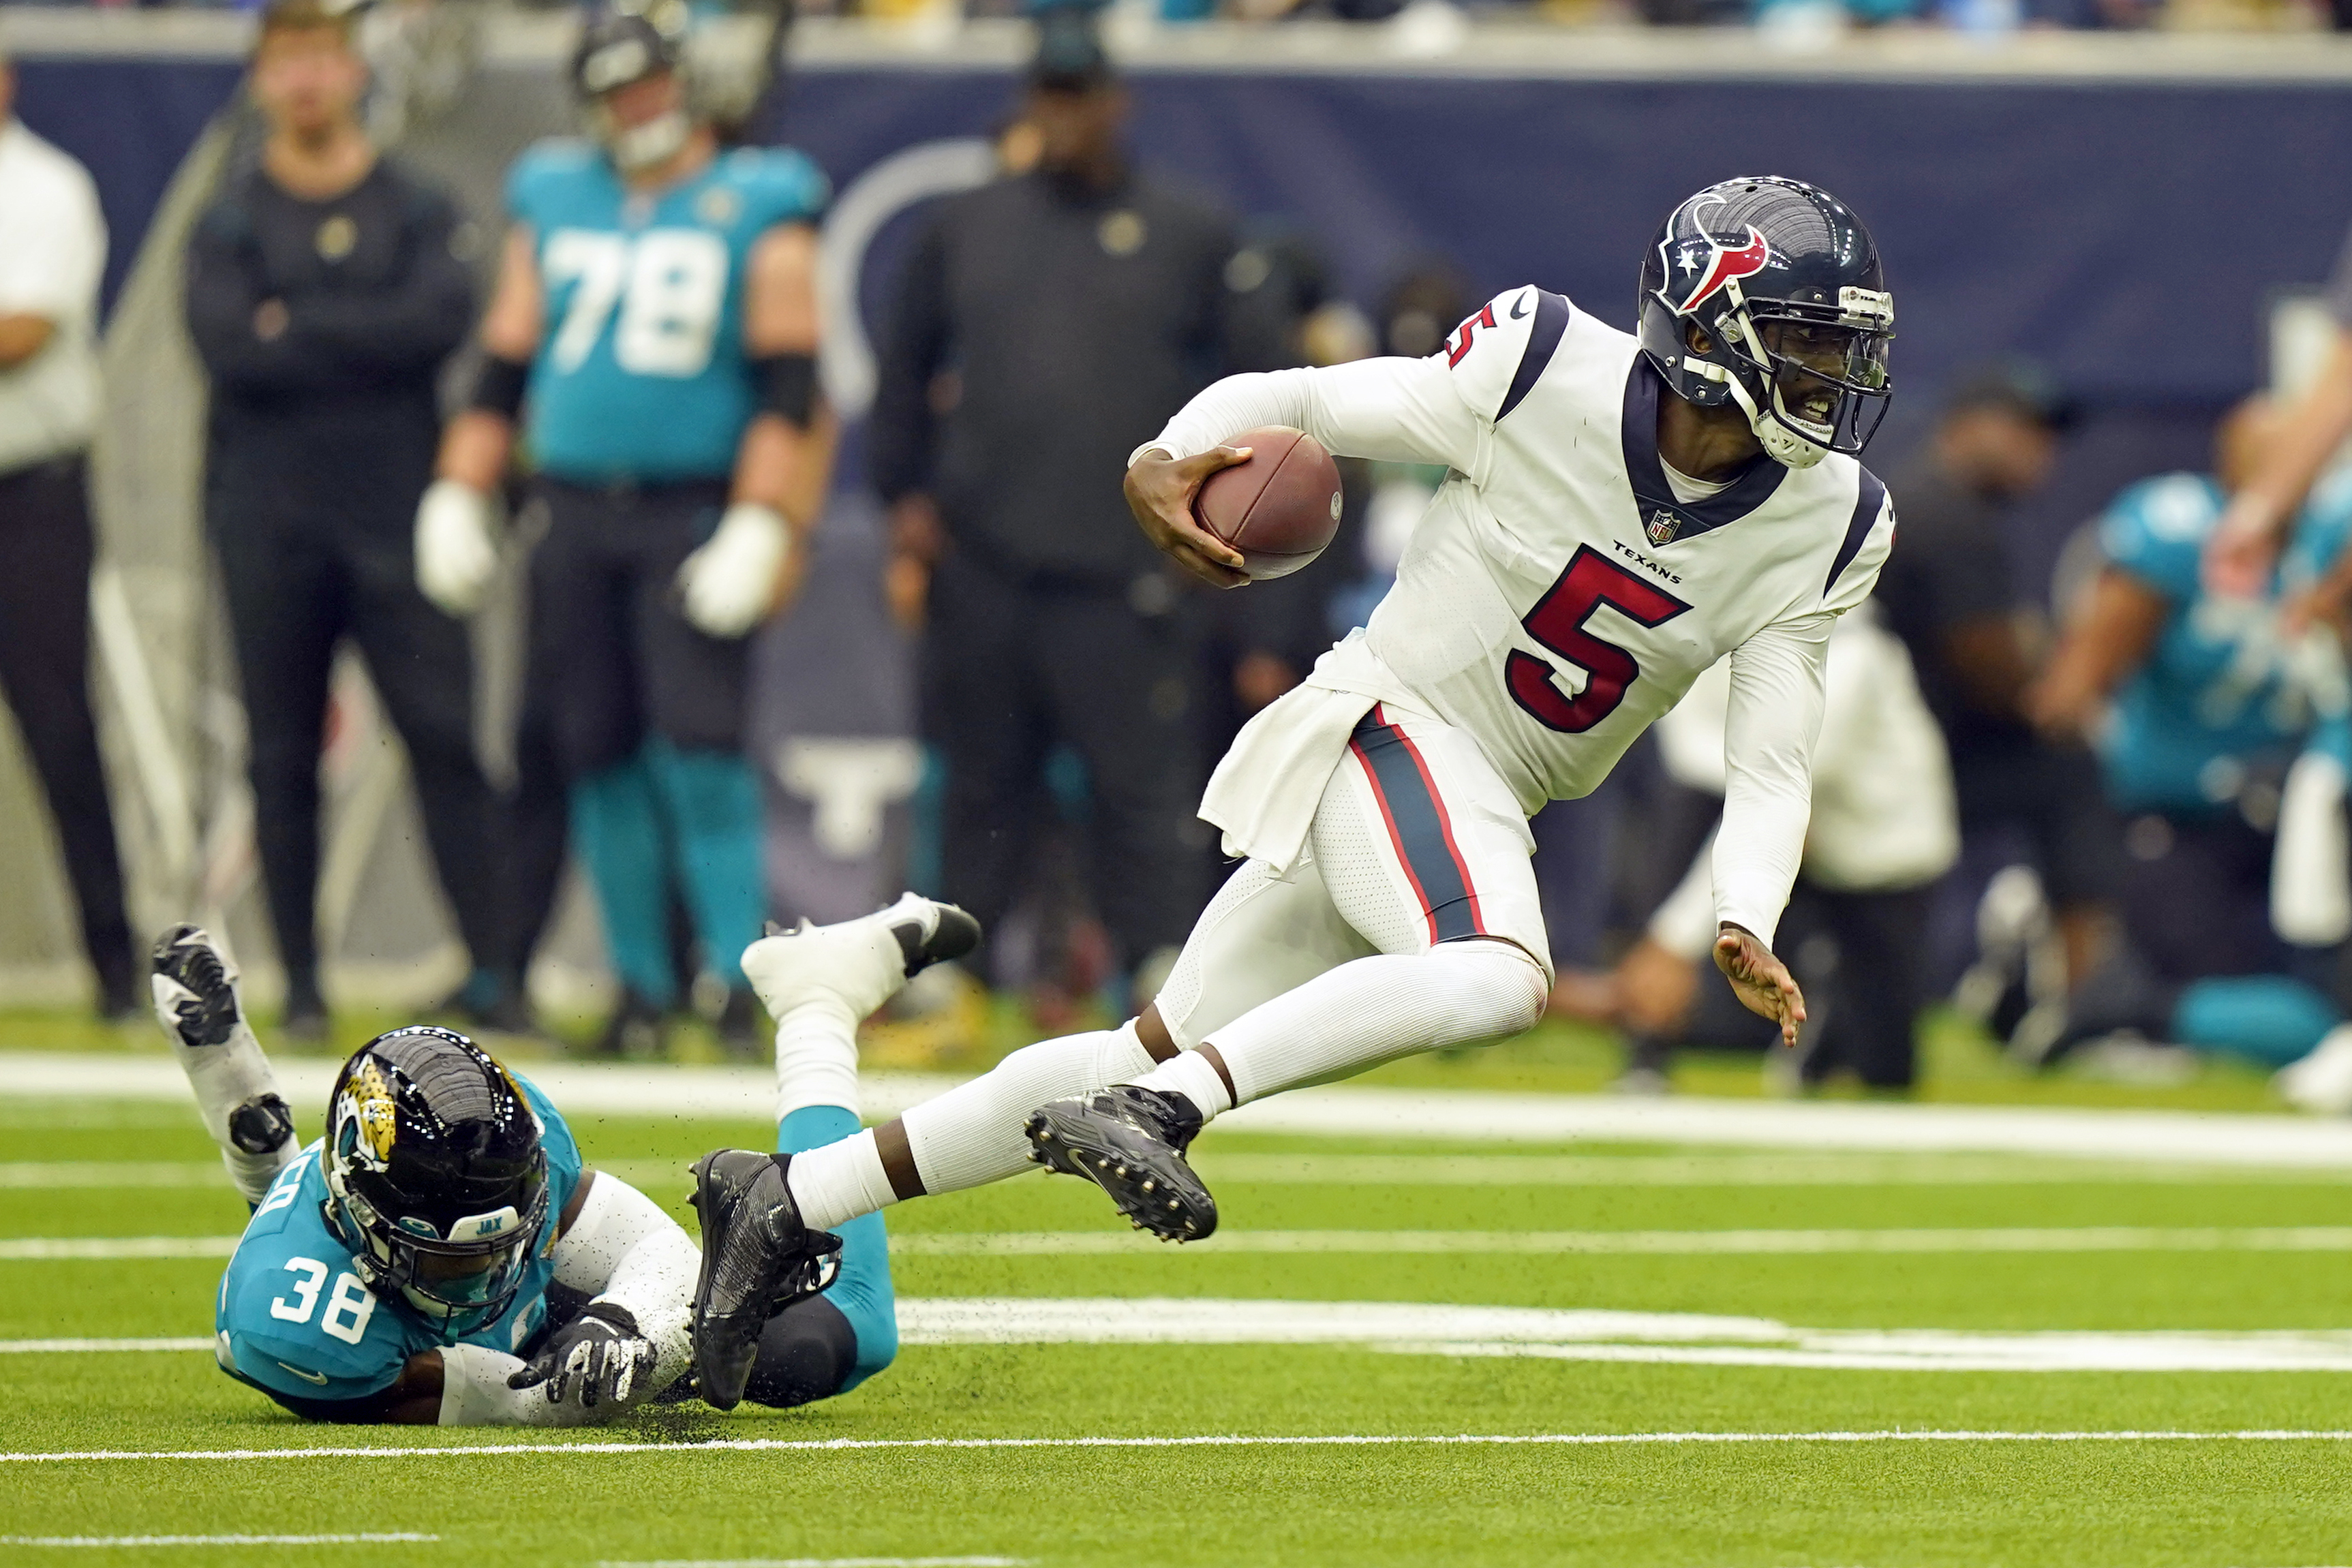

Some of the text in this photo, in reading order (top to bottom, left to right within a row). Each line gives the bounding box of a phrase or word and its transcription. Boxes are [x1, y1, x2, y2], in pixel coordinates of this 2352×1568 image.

[542, 228, 730, 378] 78
[1444, 301, 1498, 371] 5
[1613, 538, 1683, 584] TEXANS
[1651, 523, 1669, 540] NFL
[1504, 542, 1695, 733] 5
[476, 1216, 502, 1235] JAX
[270, 1256, 377, 1344] 38
